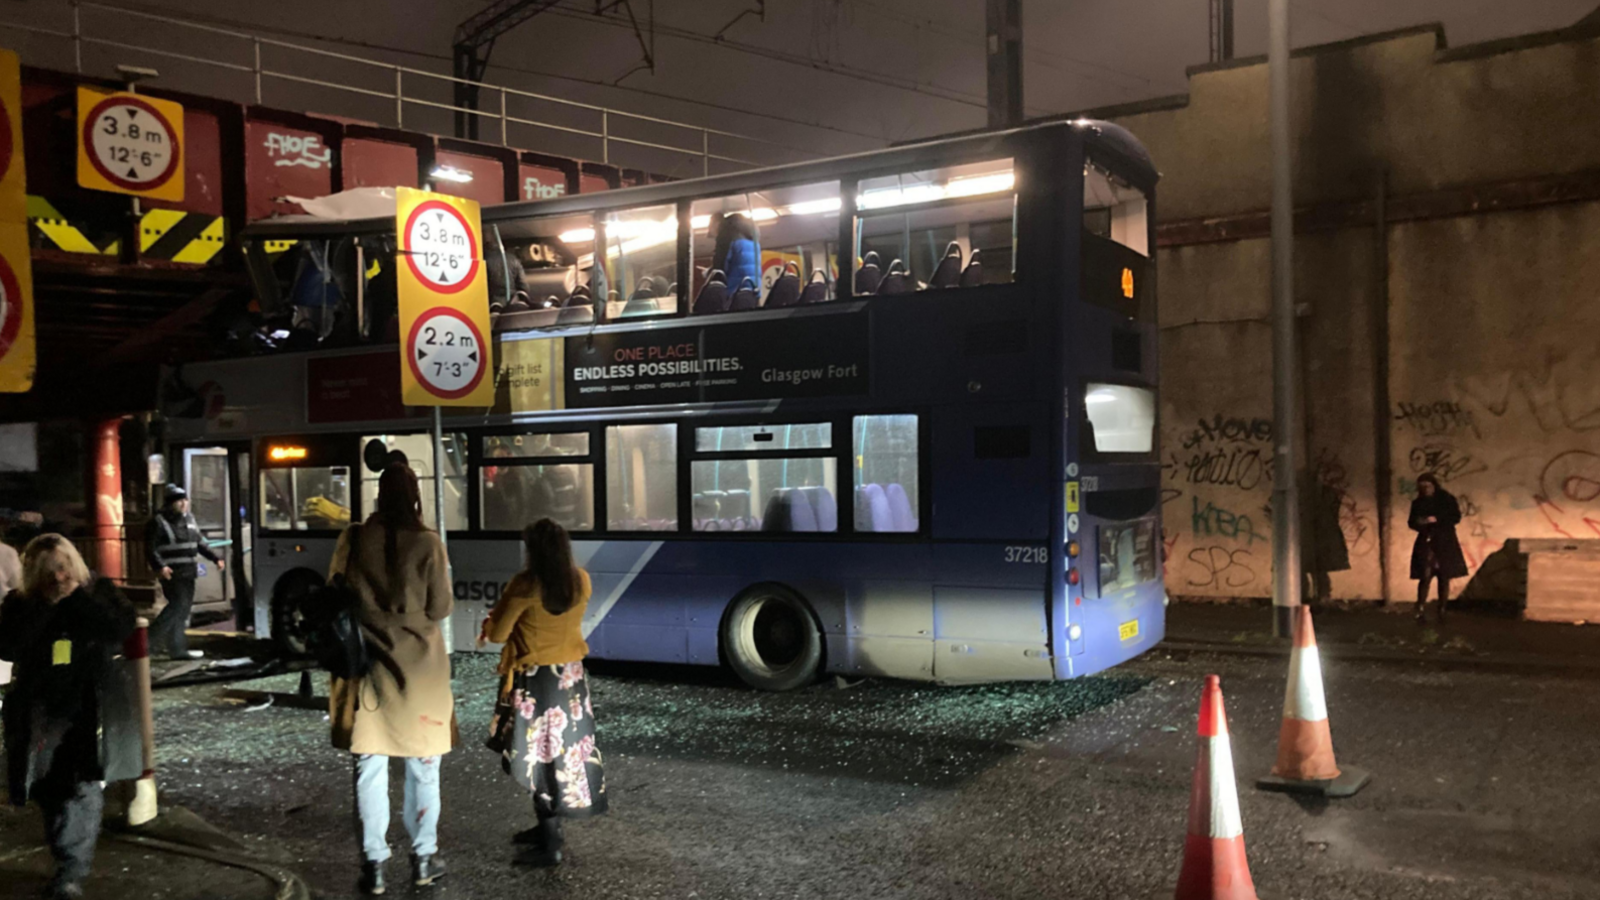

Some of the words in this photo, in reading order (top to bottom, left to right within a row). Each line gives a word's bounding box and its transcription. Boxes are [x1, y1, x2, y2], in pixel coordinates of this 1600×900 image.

[103, 115, 140, 140] 3.8
[145, 130, 162, 143] m
[419, 222, 448, 243] 3.8
[452, 234, 465, 246] m
[424, 327, 455, 346] 2.2
[460, 335, 474, 347] m
[614, 347, 645, 361] ONE
[527, 363, 543, 375] list
[573, 364, 635, 380] ENDLESS
[638, 357, 744, 376] POSSIBILITIES.
[761, 367, 824, 385] Glasgow
[827, 363, 858, 378] Fort
[1004, 546, 1049, 563] 37218
[1188, 546, 1256, 590] SPS
